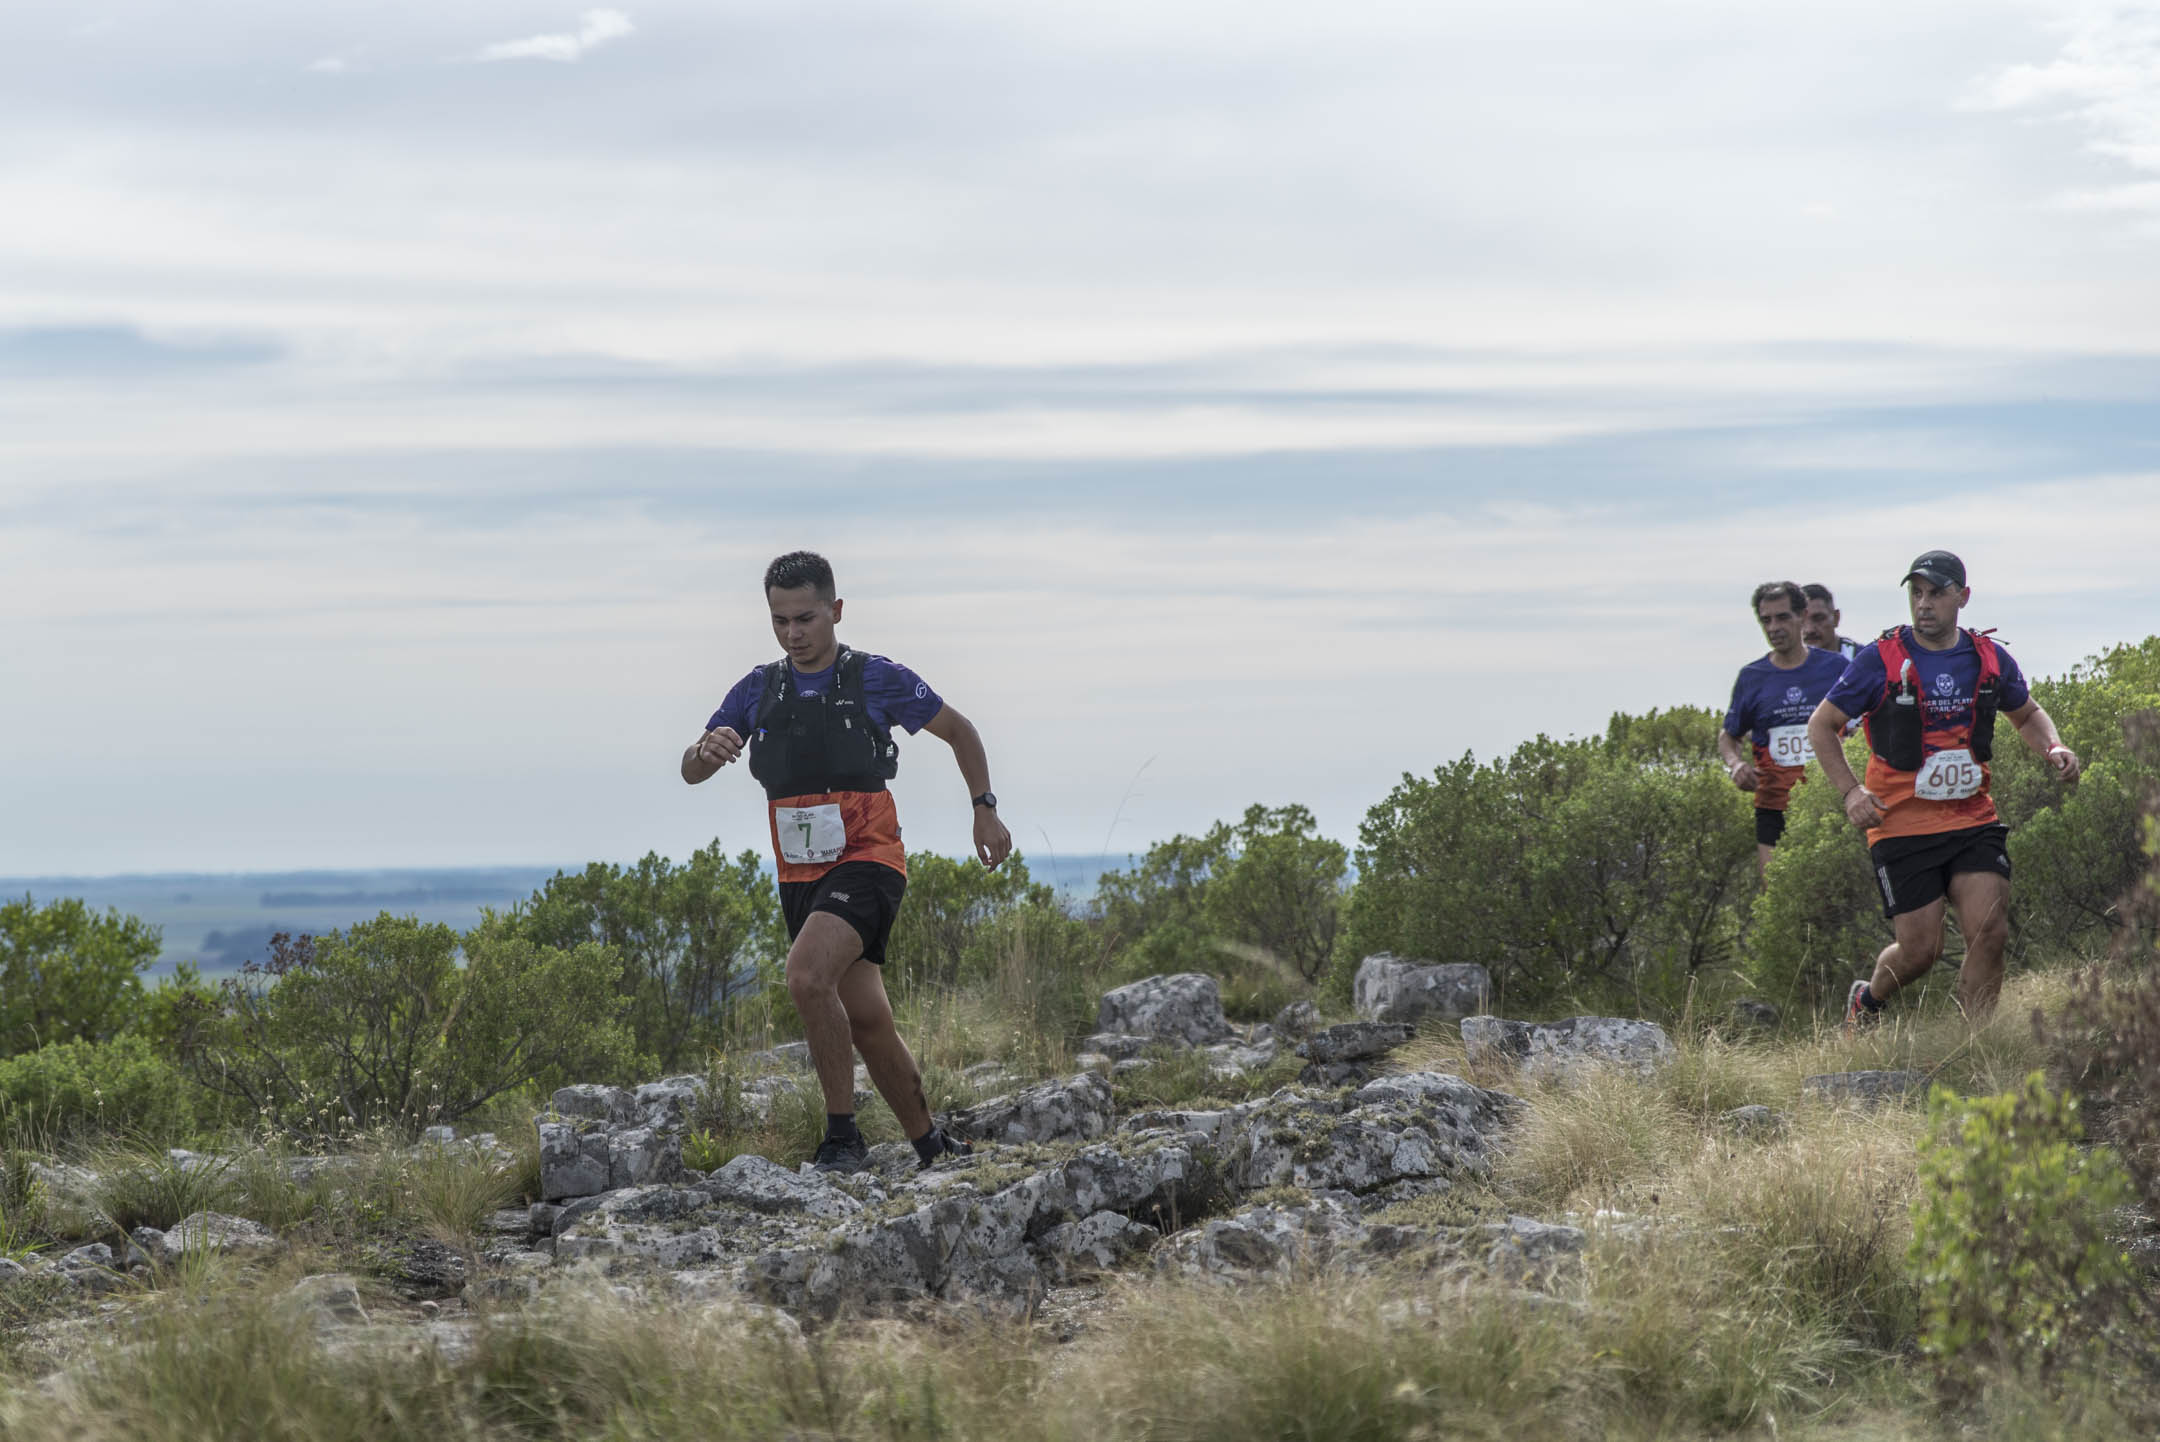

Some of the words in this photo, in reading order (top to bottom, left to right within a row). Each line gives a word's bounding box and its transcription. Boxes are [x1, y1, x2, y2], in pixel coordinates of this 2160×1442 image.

[1928, 705, 1950, 713] TRAIL
[1928, 762, 1973, 788] 605
[797, 822, 812, 849] 7
